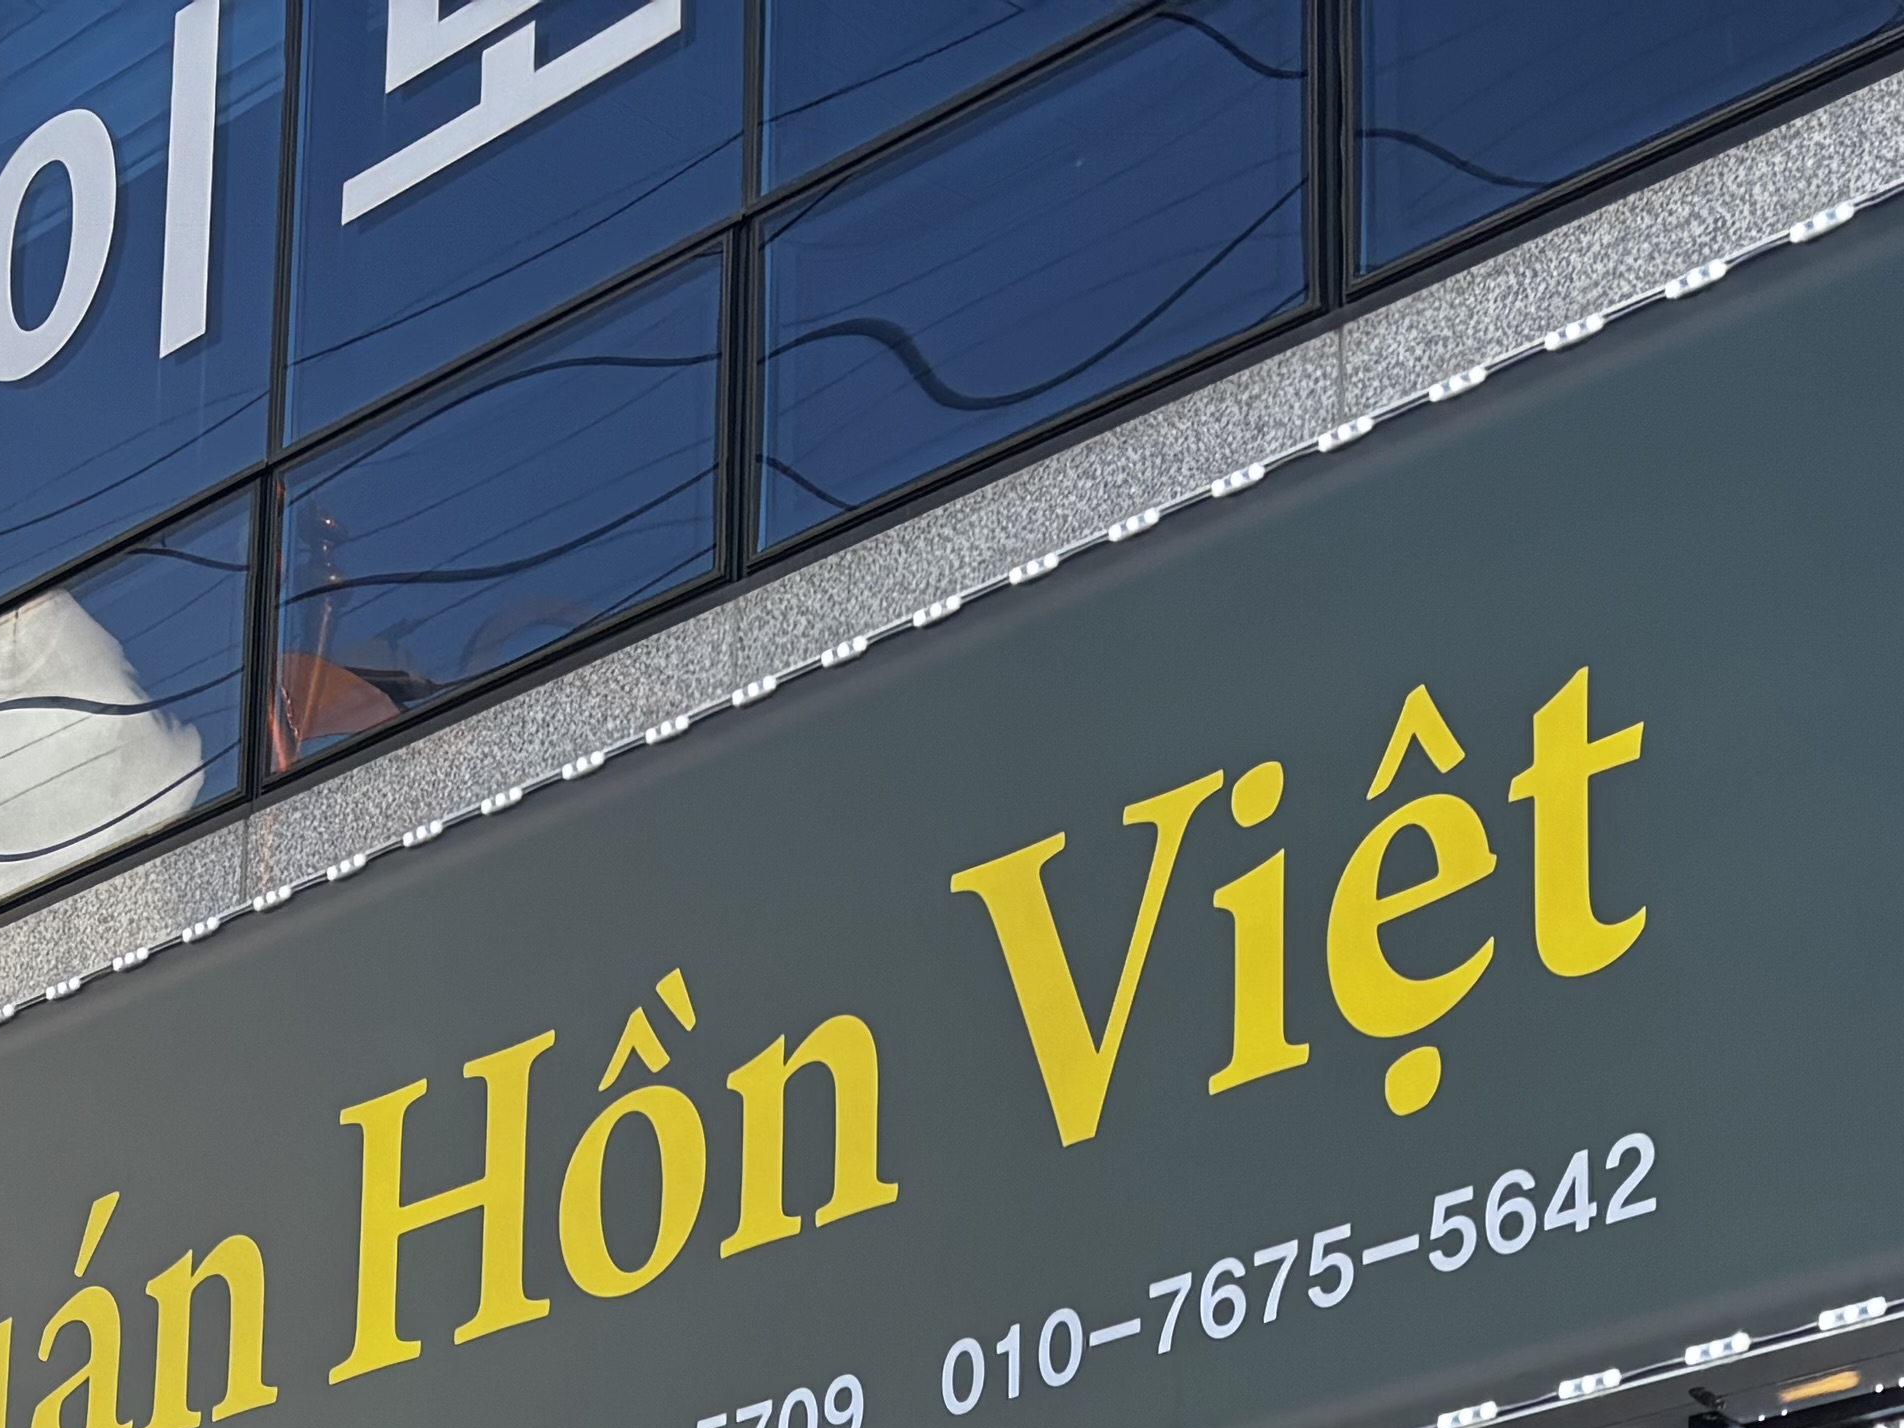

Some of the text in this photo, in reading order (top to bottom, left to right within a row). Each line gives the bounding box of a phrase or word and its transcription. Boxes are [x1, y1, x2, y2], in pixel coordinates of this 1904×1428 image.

[329, 969, 899, 1385] Hồn
[951, 667, 1647, 1147] Việt
[941, 1132, 1658, 1415] 010-7675-5642
